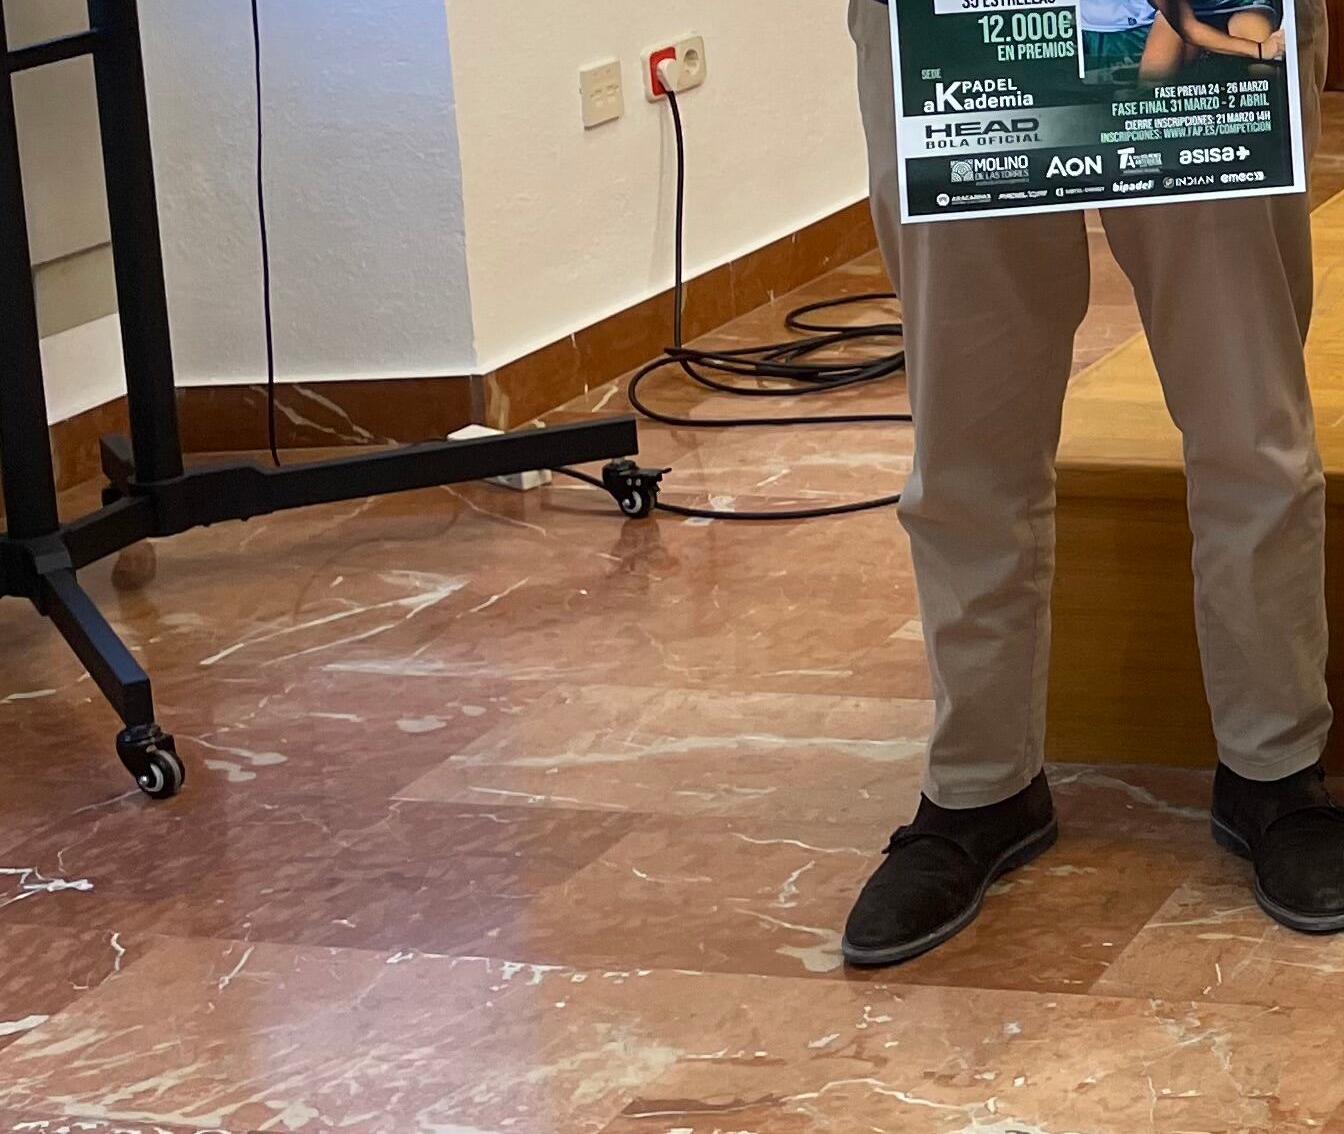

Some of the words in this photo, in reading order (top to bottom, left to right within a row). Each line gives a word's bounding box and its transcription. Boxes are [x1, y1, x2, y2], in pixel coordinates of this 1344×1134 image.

[978, 10, 1074, 44] 12.000€
[997, 44, 1015, 62] EN
[1017, 40, 1075, 60] PREMIOS
[961, 78, 1018, 94] PADEL
[1155, 85, 1176, 98] FASE
[1177, 84, 1207, 97] PREVIA
[1207, 82, 1220, 95] 24
[1226, 81, 1238, 94] 26
[1239, 79, 1269, 93] MARZO
[1112, 101, 1137, 116] FASE
[1139, 99, 1169, 115] FINAL
[1170, 98, 1182, 113] 31
[1184, 96, 1220, 111] MARZO
[1228, 95, 1236, 109] 2
[1240, 93, 1270, 108] ABRIL
[925, 117, 1040, 139] HEAD
[1216, 113, 1226, 125] 21
[1226, 111, 1253, 123] MARZO
[925, 138, 970, 150] BOLA
[976, 133, 1043, 146] OFICIAL
[973, 155, 1029, 172] MOLINO
[1046, 154, 1103, 179] AON
